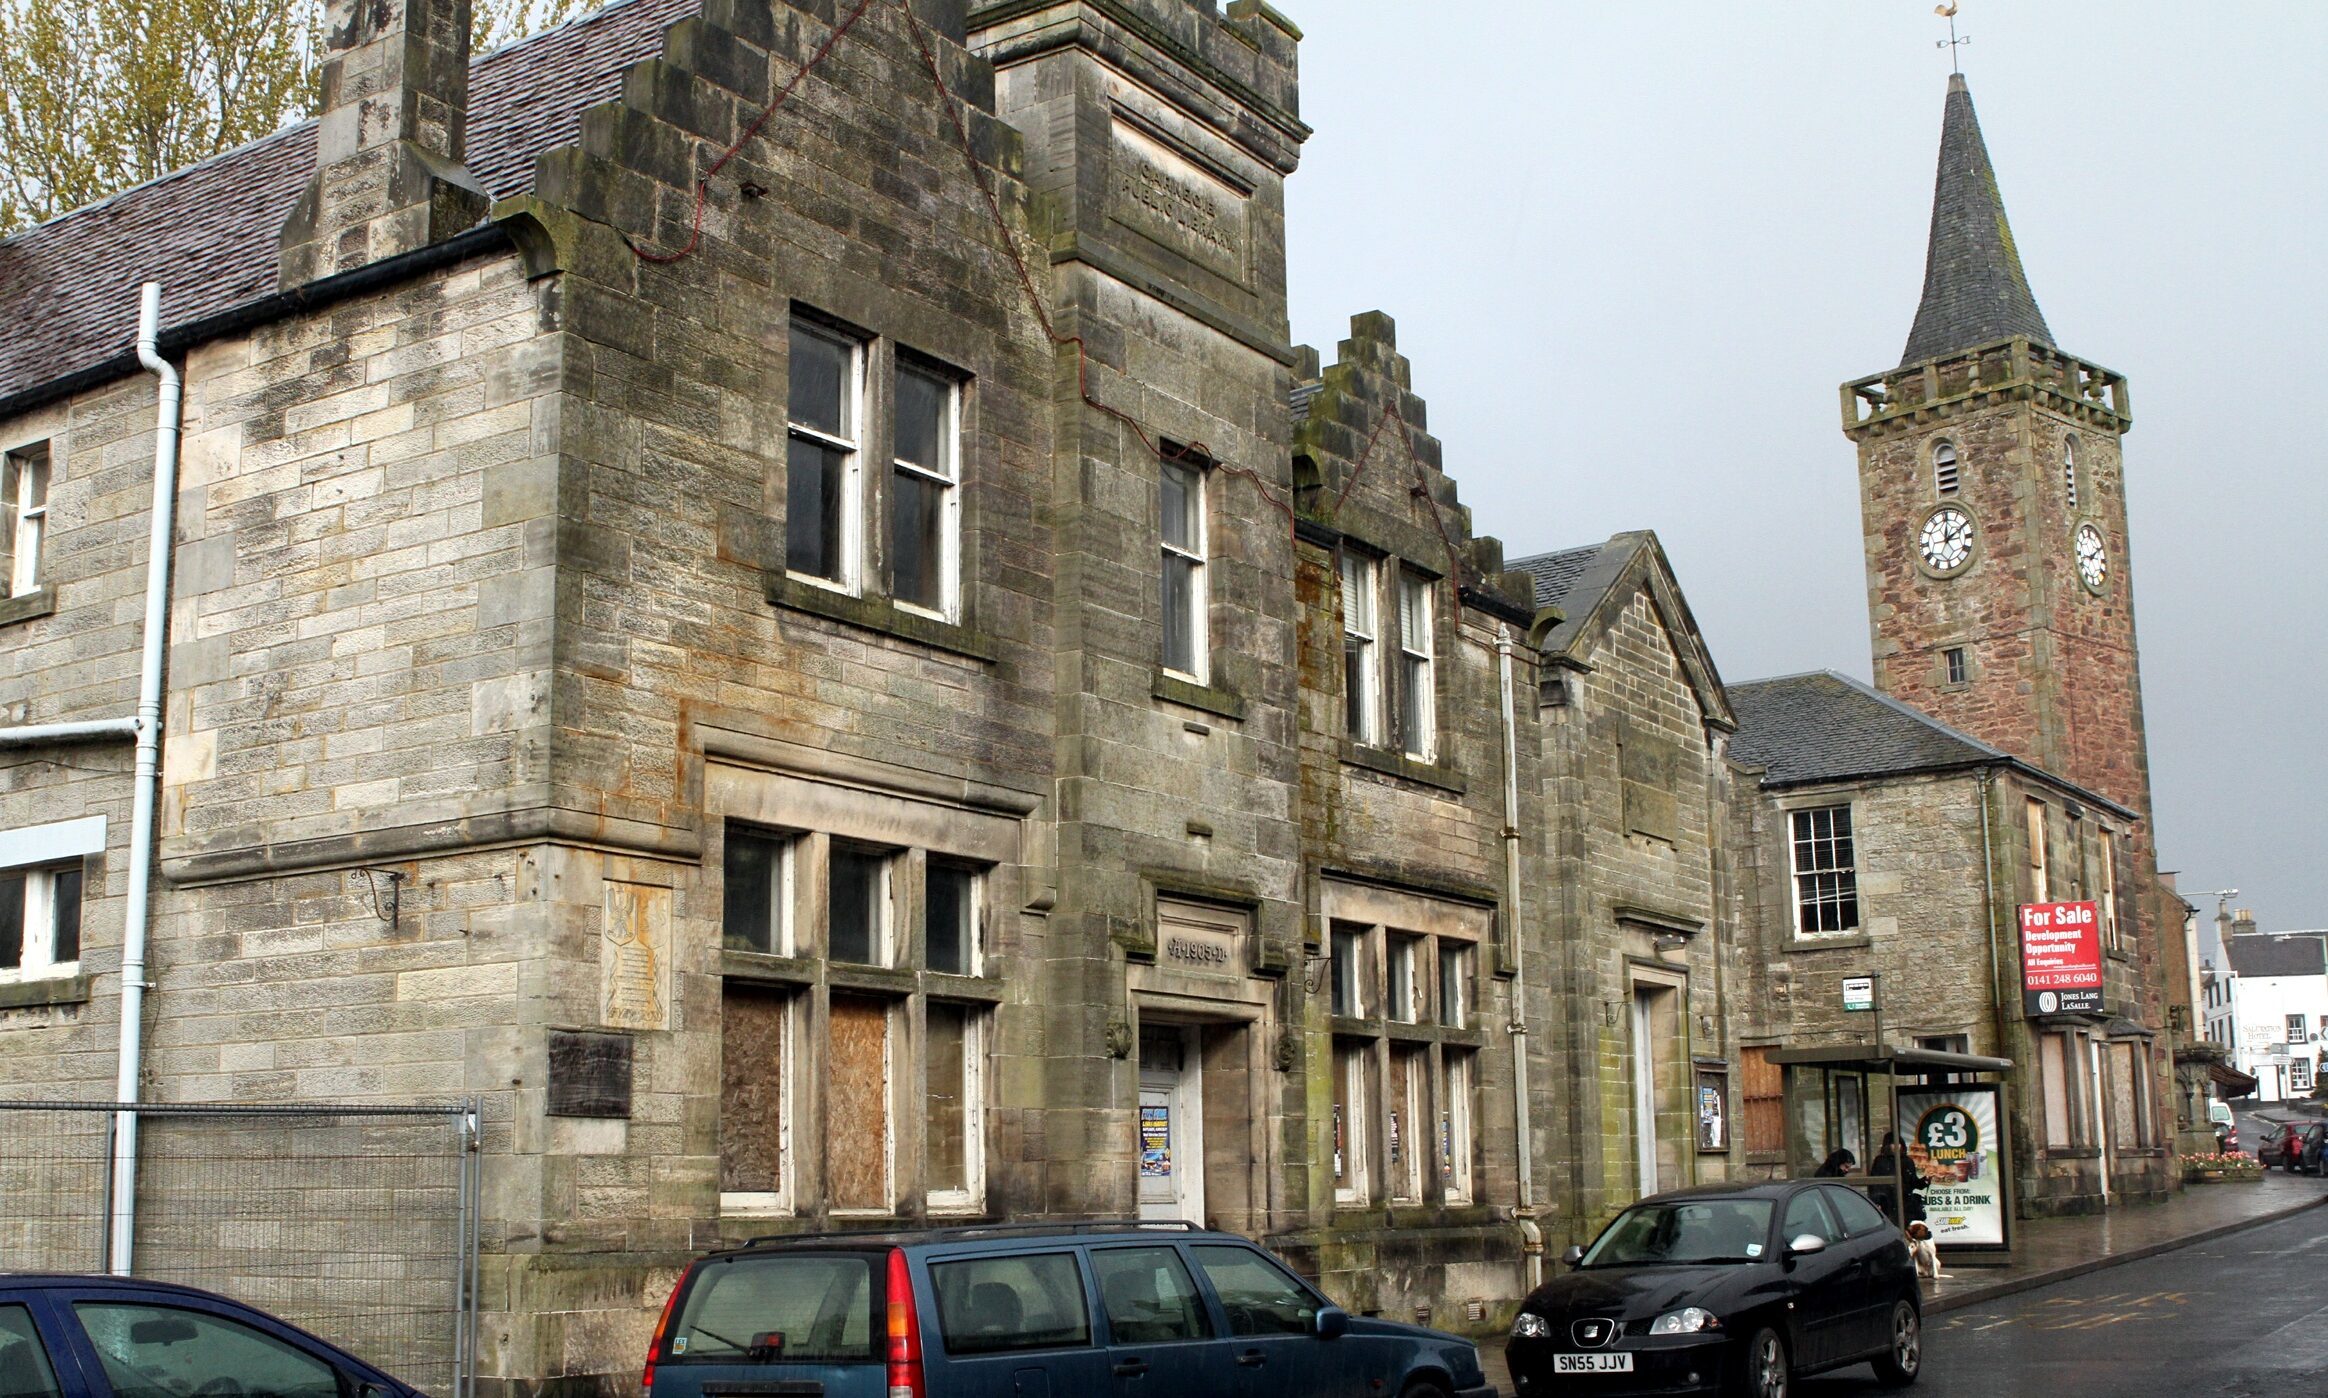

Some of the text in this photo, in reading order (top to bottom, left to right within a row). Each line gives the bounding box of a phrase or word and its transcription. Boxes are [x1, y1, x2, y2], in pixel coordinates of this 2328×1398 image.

[1141, 163, 1216, 219] CARNEGIE
[1121, 178, 1173, 218] PUBLIC
[2024, 905, 2092, 927] For Sale
[2025, 929, 2082, 942] Development
[2025, 941, 2076, 955] Opportunity
[2027, 958, 2036, 966] All
[2036, 958, 2064, 968] Enquiries
[2027, 972, 2097, 985] 0141 248 6040
[2247, 1032, 2272, 1040] HOTEL
[1927, 1111, 1967, 1148] £3
[1930, 1148, 1967, 1160] LUNCH
[1945, 1195, 1952, 1206] &
[1954, 1195, 1961, 1205] A
[1963, 1195, 1992, 1205] DRINK
[1560, 1355, 1626, 1371] SN55 JJV
